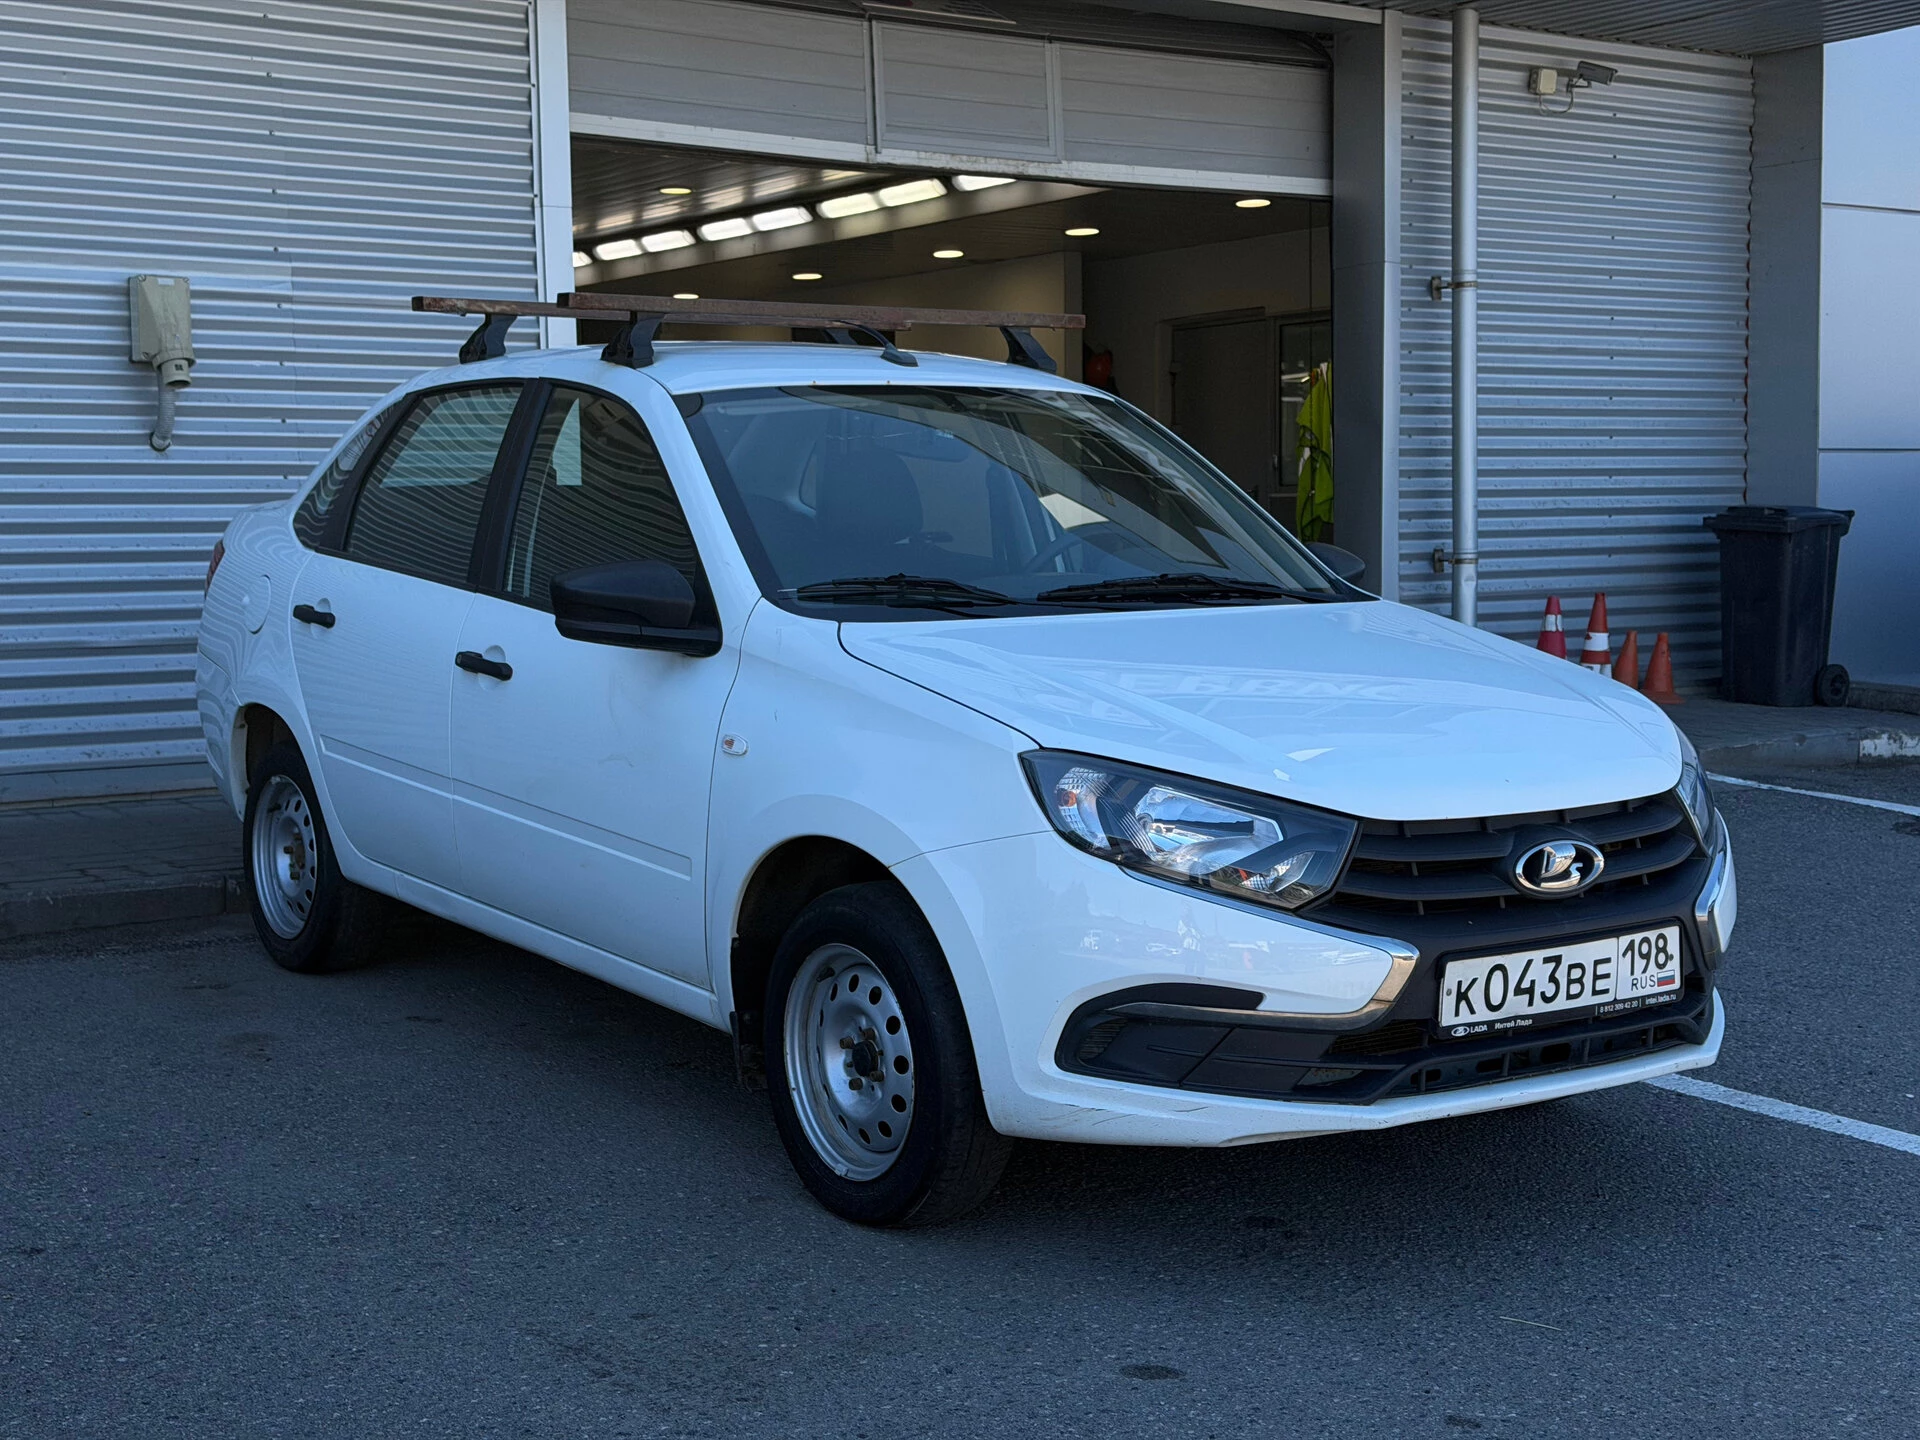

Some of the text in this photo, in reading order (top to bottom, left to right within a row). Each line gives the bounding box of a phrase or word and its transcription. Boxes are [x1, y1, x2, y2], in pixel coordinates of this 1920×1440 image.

[1622, 932, 1669, 977] 198
[1630, 975, 1656, 992] RUS
[1470, 1024, 1488, 1034] LADA
[1515, 1018, 1533, 1028] Лада
